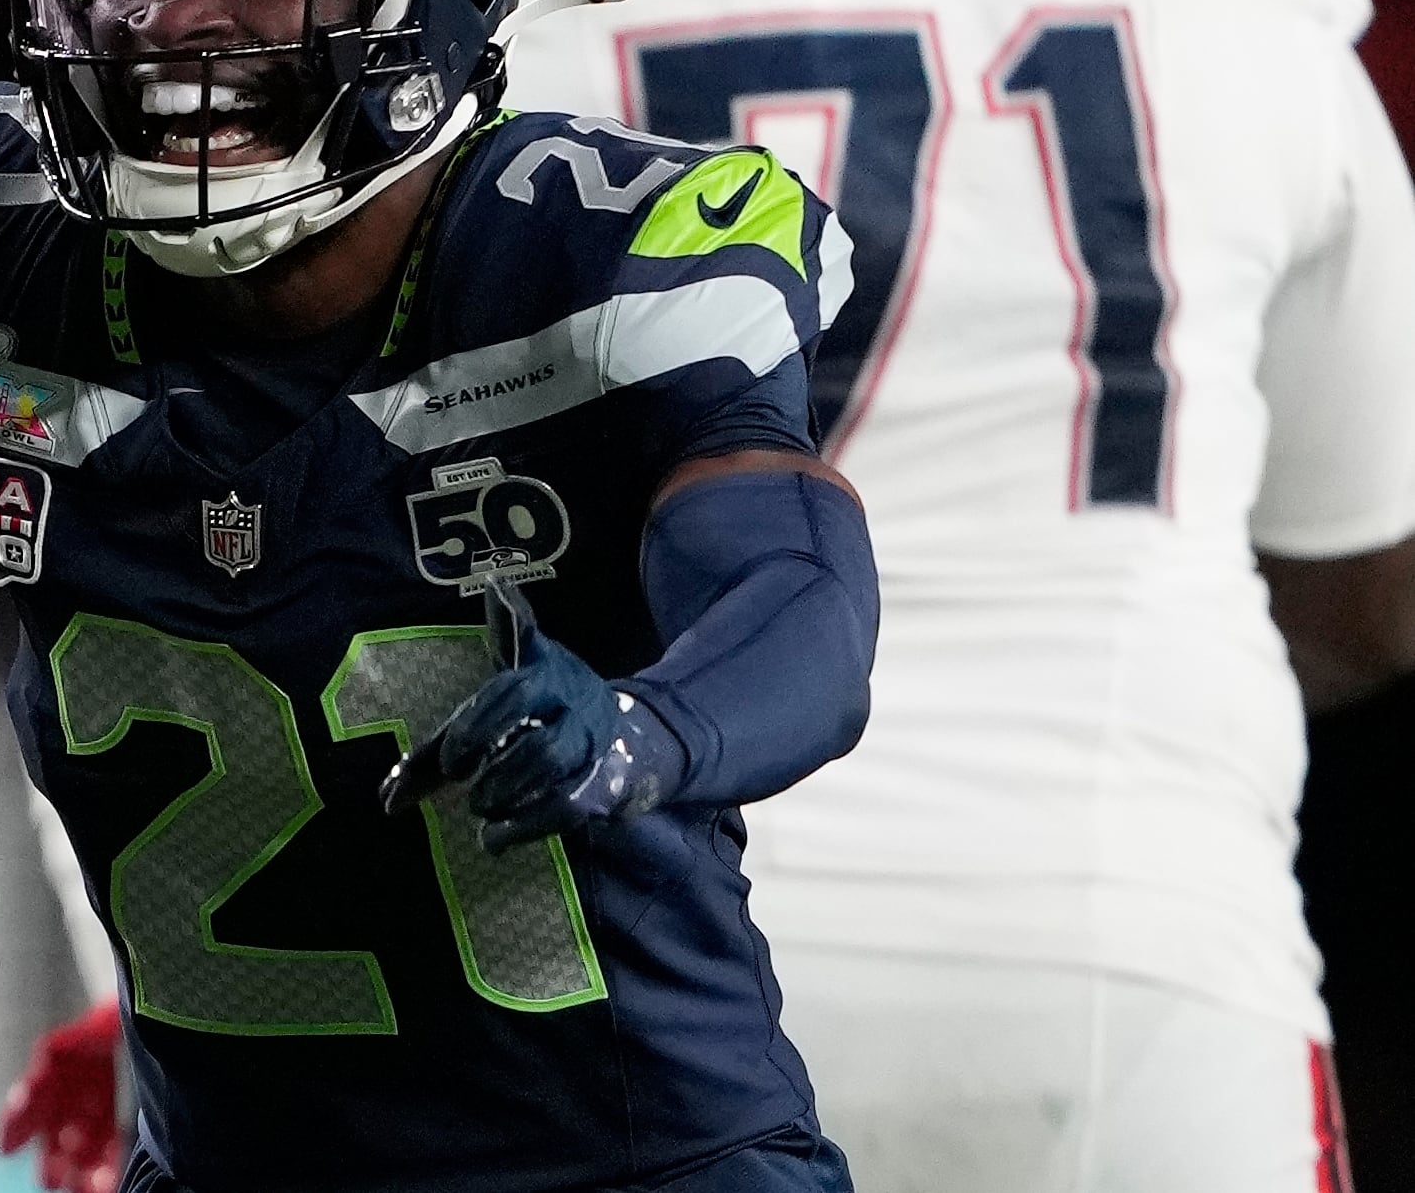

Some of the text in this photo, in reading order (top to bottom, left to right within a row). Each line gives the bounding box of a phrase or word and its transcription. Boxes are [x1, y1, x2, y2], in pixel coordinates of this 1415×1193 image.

[613, 5, 1179, 518] 71
[424, 363, 556, 414] SEAHAWKS
[211, 530, 252, 560] NFL
[411, 477, 565, 581] 50
[50, 612, 608, 1036] 21
